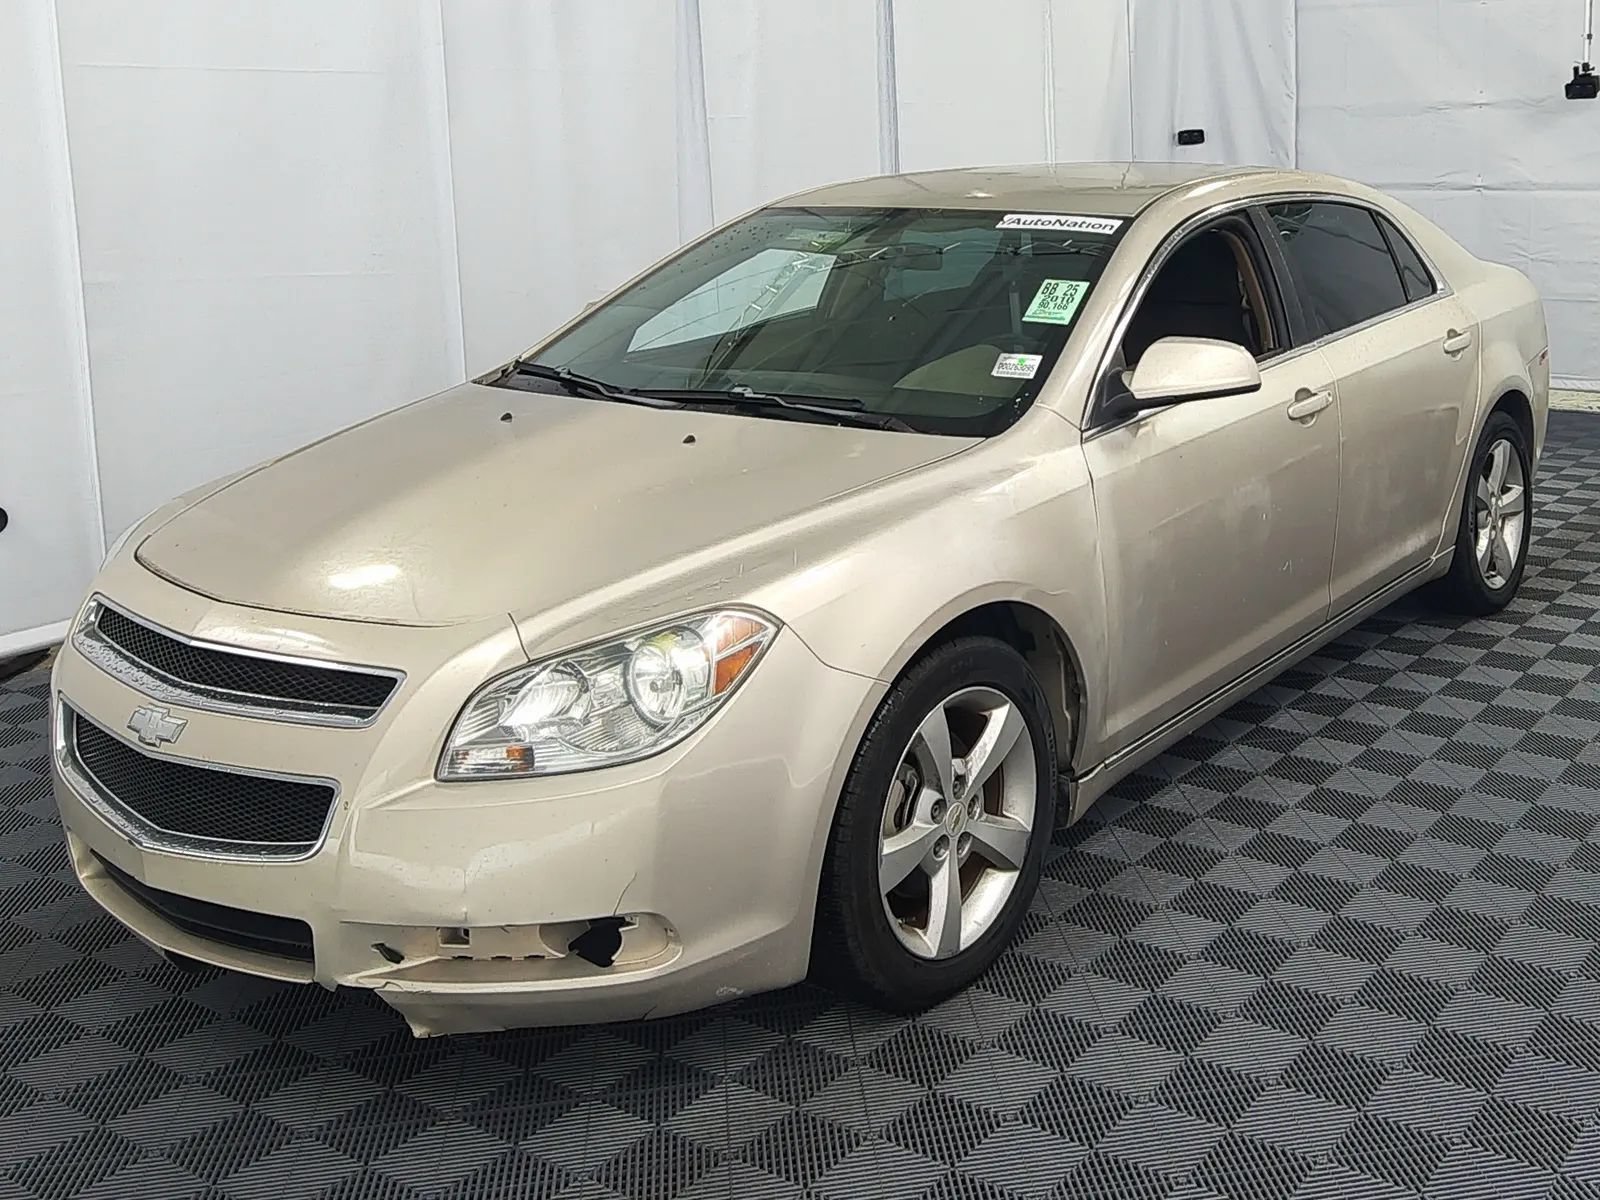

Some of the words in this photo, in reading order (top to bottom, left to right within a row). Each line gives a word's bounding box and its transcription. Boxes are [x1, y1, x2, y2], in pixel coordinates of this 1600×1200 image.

[1009, 217, 1115, 231] AutoNation
[1041, 282, 1059, 295] BB
[1063, 283, 1080, 297] 25
[1042, 294, 1075, 303] 2010
